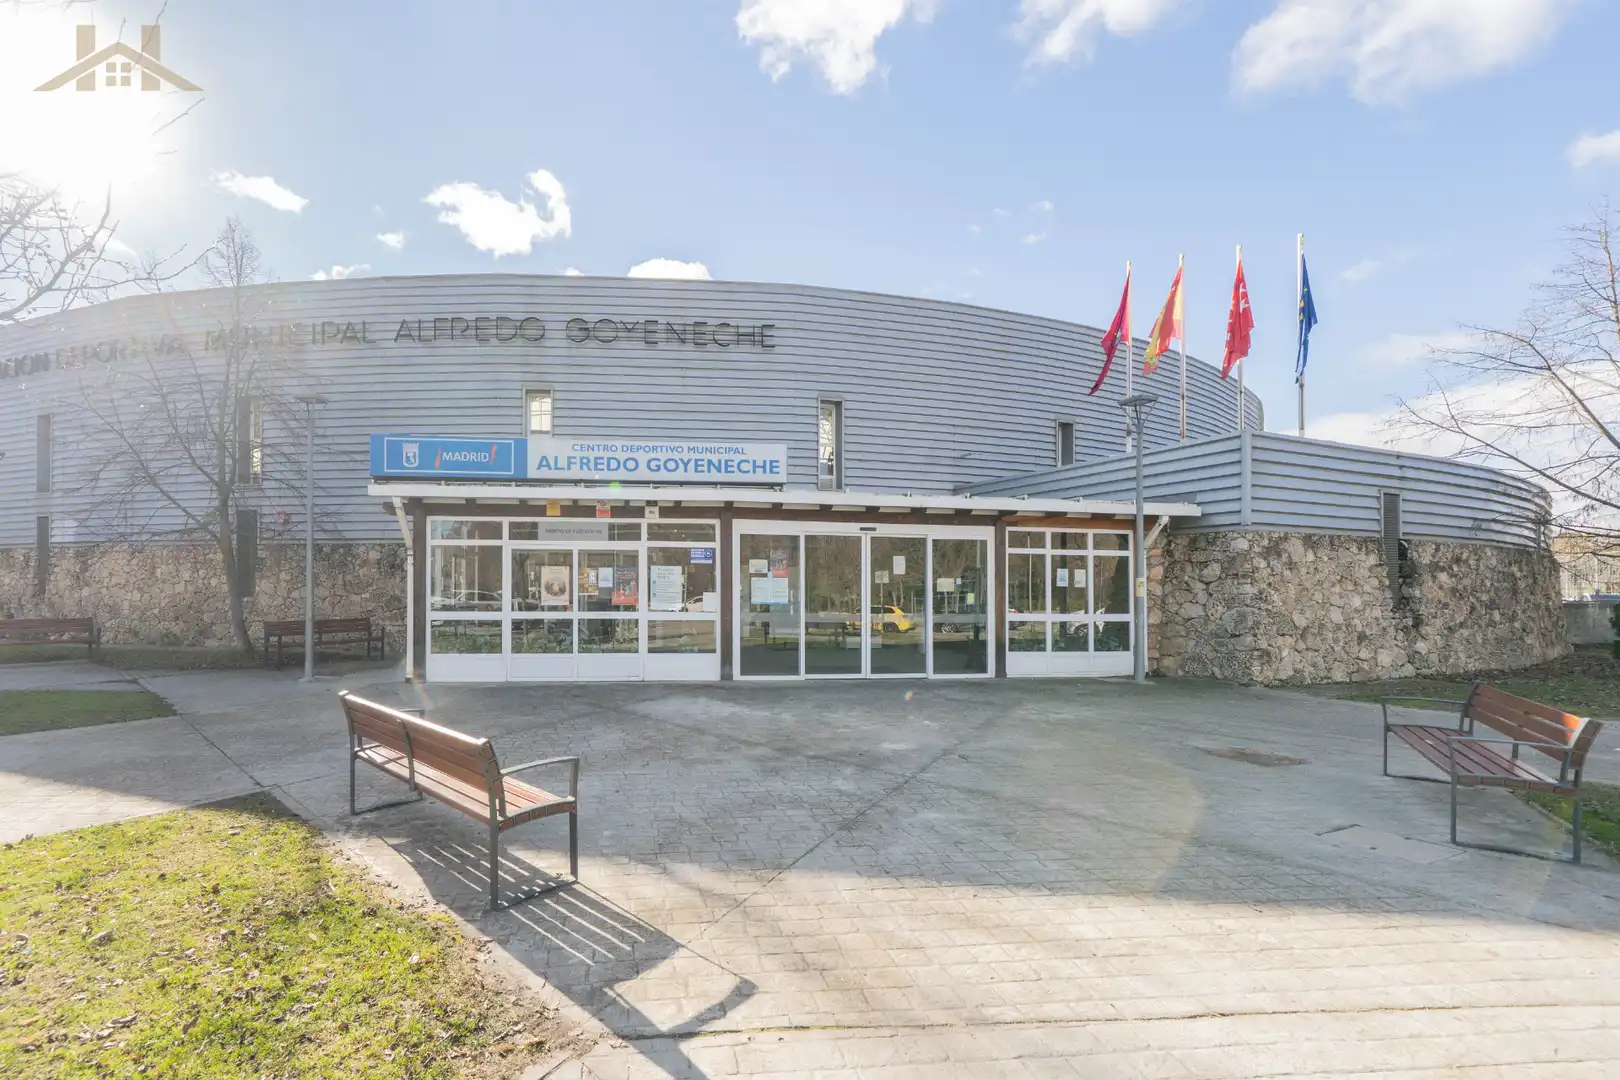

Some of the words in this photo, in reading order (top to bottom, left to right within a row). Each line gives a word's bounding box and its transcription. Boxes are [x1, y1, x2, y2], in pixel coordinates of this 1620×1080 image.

[394, 316, 546, 343] ALFREDO
[565, 317, 776, 348] GOYENECHE
[571, 443, 618, 453] CENTRO
[621, 444, 685, 454] DEPORTIVO
[687, 446, 748, 455] MUNICIPAL
[536, 455, 640, 472] ALFREDO
[646, 457, 781, 475] GOYENECHE
